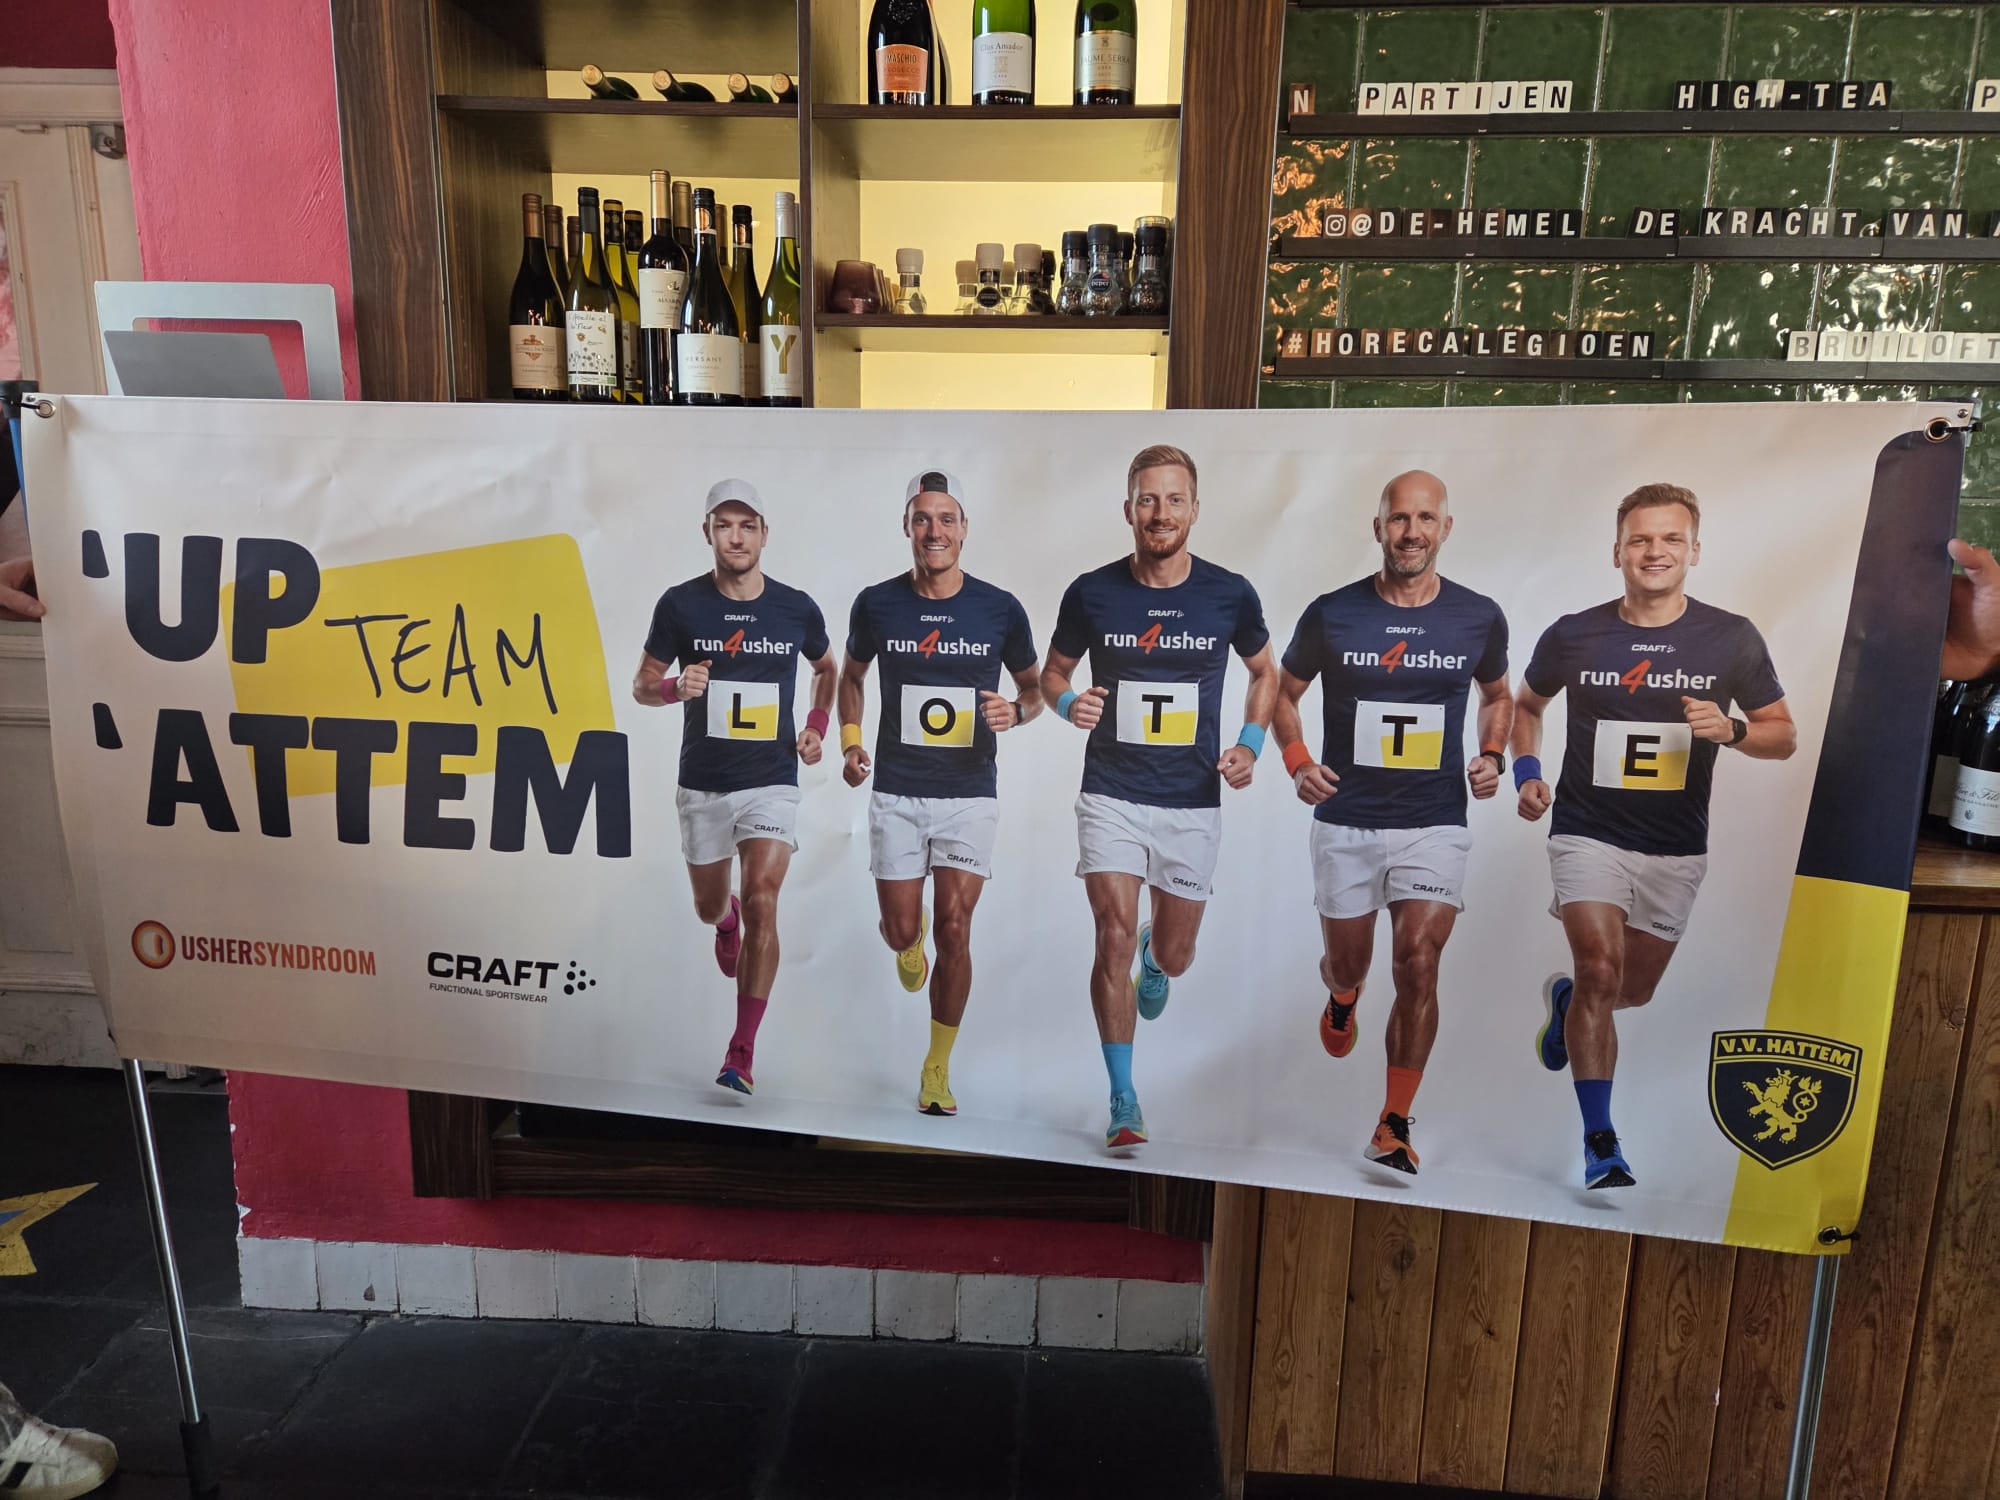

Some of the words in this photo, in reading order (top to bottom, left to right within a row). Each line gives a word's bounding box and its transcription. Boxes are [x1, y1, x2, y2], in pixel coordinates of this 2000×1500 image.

[1292, 89, 1309, 113] N
[1364, 85, 1567, 111] PARTIJEN
[1677, 82, 1887, 109] HIGH-TEA
[1981, 84, 1997, 107] P
[1634, 211, 1675, 236] DE
[1704, 211, 1857, 236] KRACHT
[1892, 212, 1963, 237] VAN
[770, 334, 797, 374] Y
[1287, 331, 1650, 358] #HORECALEGIOEN
[1794, 334, 2000, 360] BRUILOFT
[724, 614, 751, 622] CRAFT
[920, 614, 947, 623] CRAFT
[1147, 609, 1177, 617] CRAFT
[693, 628, 793, 658] run4usher
[887, 628, 991, 659] run4usher
[1104, 623, 1217, 655] run4usher
[1385, 626, 1416, 635] CRAFT
[324, 603, 558, 715] TEAM
[1343, 640, 1467, 674] run4usher
[1631, 643, 1666, 653] CRAFT
[1580, 659, 1717, 694] run4usher
[732, 692, 756, 730] L
[918, 697, 956, 737] O
[1141, 694, 1174, 734] T
[1381, 714, 1418, 757] T
[1623, 733, 1661, 778] E
[754, 824, 781, 834] CRAFT
[946, 854, 974, 865] CRAFT
[1172, 877, 1198, 890] CRAFT
[1412, 883, 1445, 895] CRAFT
[1652, 921, 1675, 934] CRAFT
[181, 935, 377, 976] USHERSYNDROOM
[427, 951, 560, 989] CRAFT
[429, 982, 484, 997] FUNCTIONAL
[485, 989, 548, 1003] SPORTSWEAR
[1721, 1037, 1763, 1053] V.V.
[1767, 1038, 1852, 1068] HATTEM
